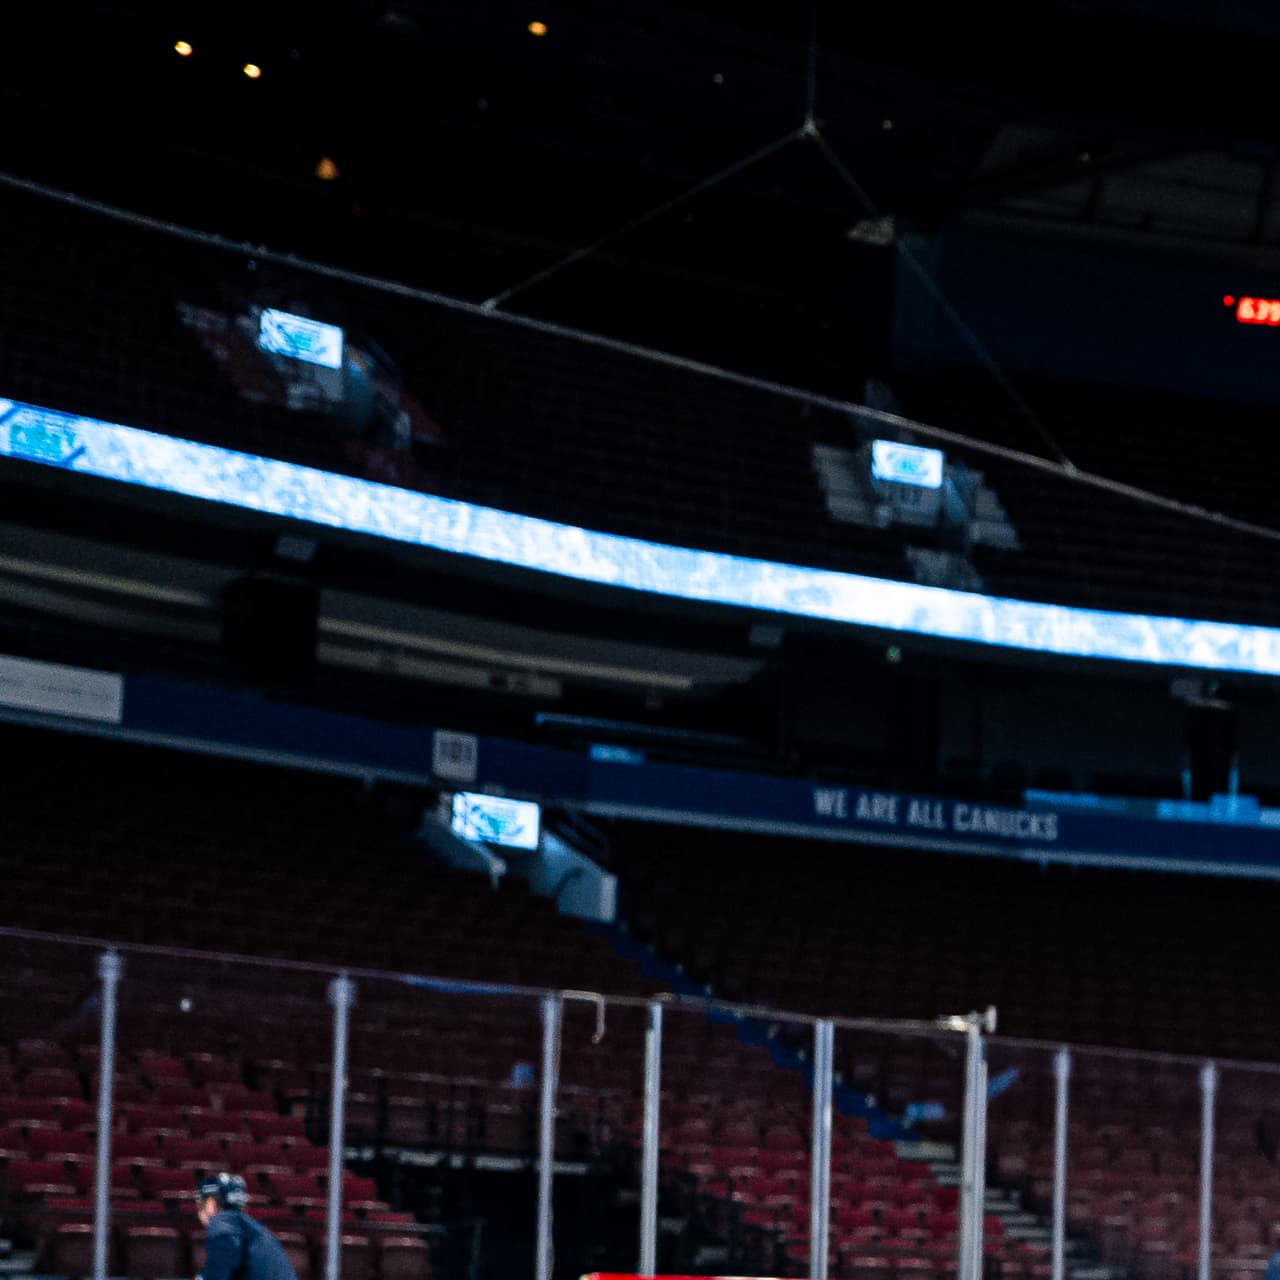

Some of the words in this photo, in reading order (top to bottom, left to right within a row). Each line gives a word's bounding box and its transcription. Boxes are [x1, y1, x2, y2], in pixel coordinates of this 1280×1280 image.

[814, 787, 847, 818] WE
[856, 792, 897, 825] ARE
[907, 799, 947, 830] ALL
[953, 803, 1059, 841] CANUCKS
